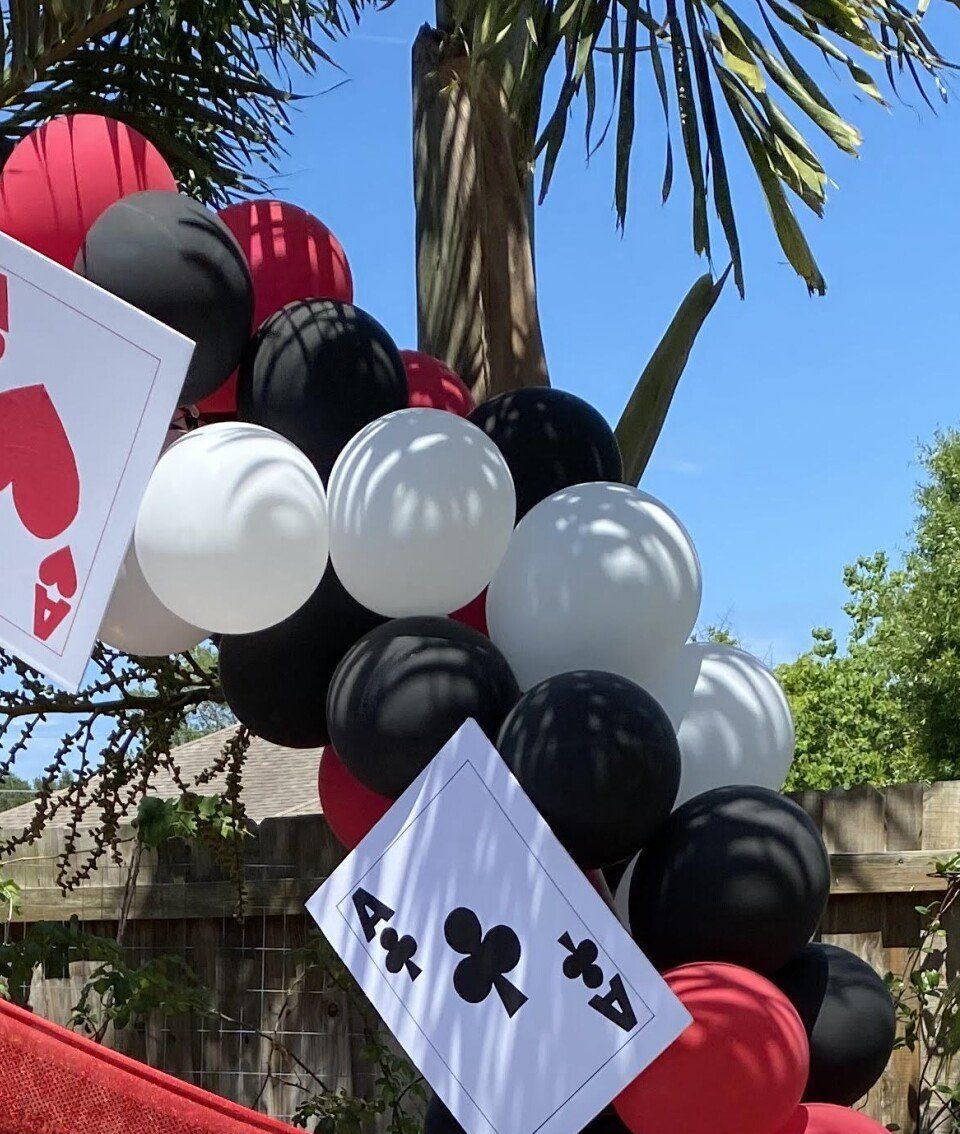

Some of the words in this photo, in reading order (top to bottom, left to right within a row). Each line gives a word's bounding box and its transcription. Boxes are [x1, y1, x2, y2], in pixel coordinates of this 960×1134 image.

[33, 583, 72, 641] A
[351, 887, 396, 943] A
[588, 973, 638, 1033] A
